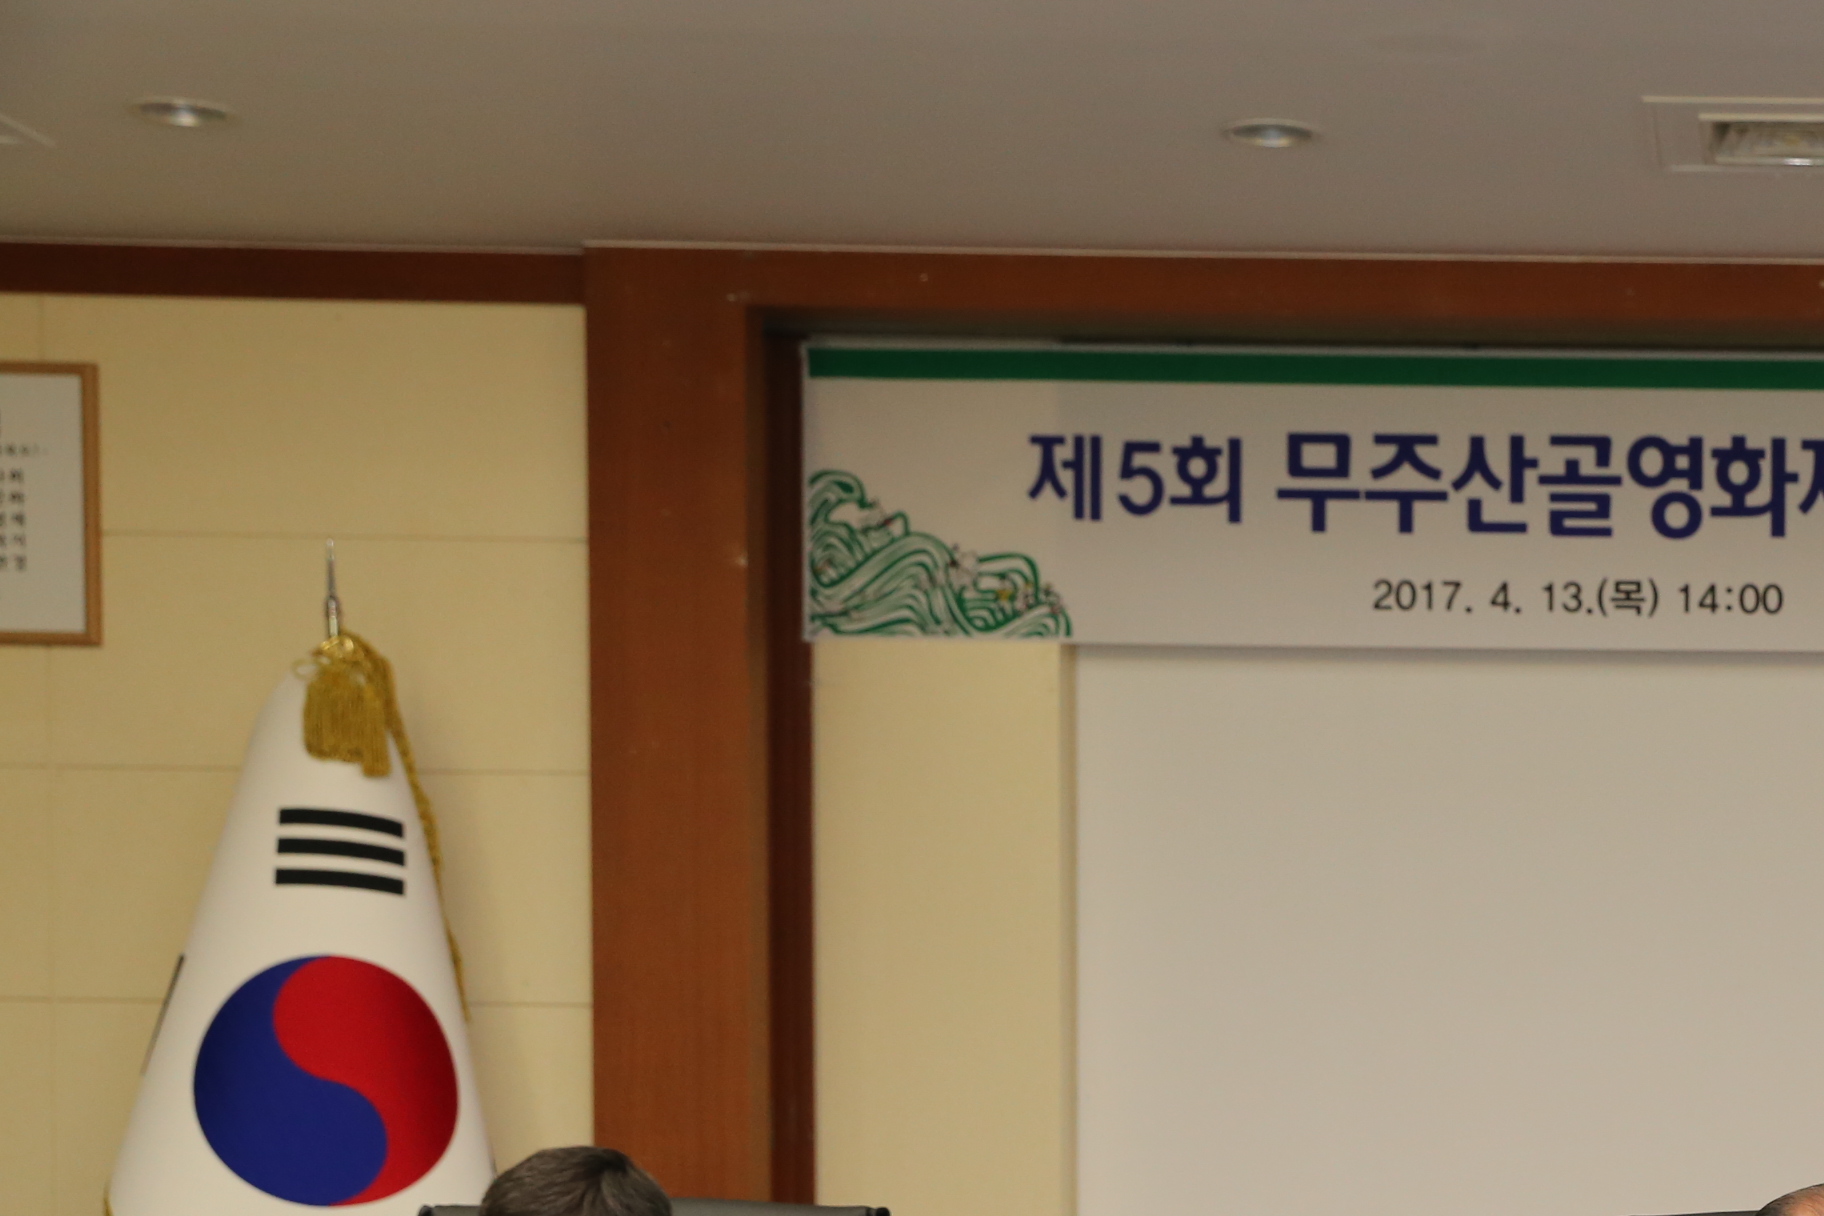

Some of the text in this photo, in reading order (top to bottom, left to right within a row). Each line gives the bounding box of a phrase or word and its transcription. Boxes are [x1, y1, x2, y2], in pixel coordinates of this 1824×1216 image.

[1027, 433, 1243, 525] 제5회
[1372, 578, 1785, 617] 2017. 4. 13.(목) 14:00
